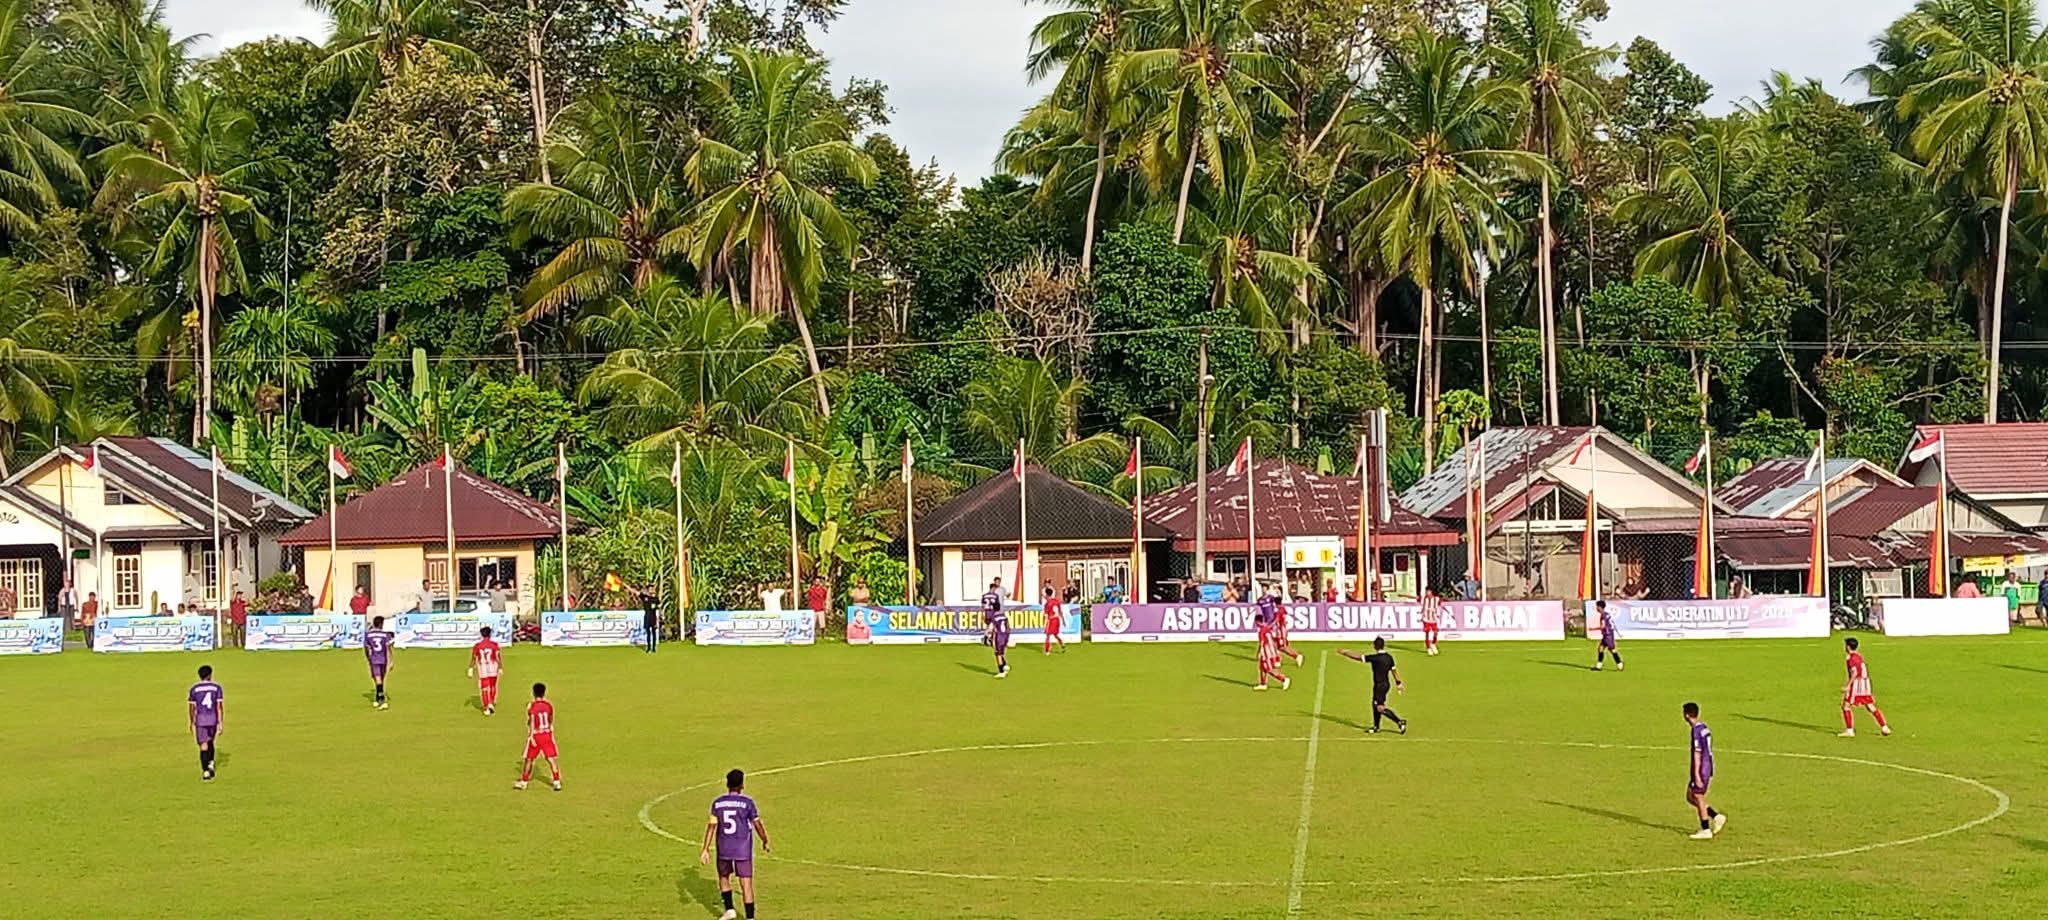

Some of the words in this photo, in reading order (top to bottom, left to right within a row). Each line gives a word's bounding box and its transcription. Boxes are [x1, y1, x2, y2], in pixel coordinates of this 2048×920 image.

[889, 611, 953, 630] SELAMAT
[1162, 606, 1257, 631] ASPROV
[1282, 606, 1317, 630] SSI
[1327, 606, 1457, 629] SUMATEA
[1463, 605, 1537, 629] BARAT
[1631, 606, 1664, 621] PIALA
[1667, 606, 1724, 621] SOERATIN
[1726, 605, 1749, 620] U17
[372, 637, 382, 652] 3
[201, 691, 213, 709] 4
[723, 810, 737, 835] 5
